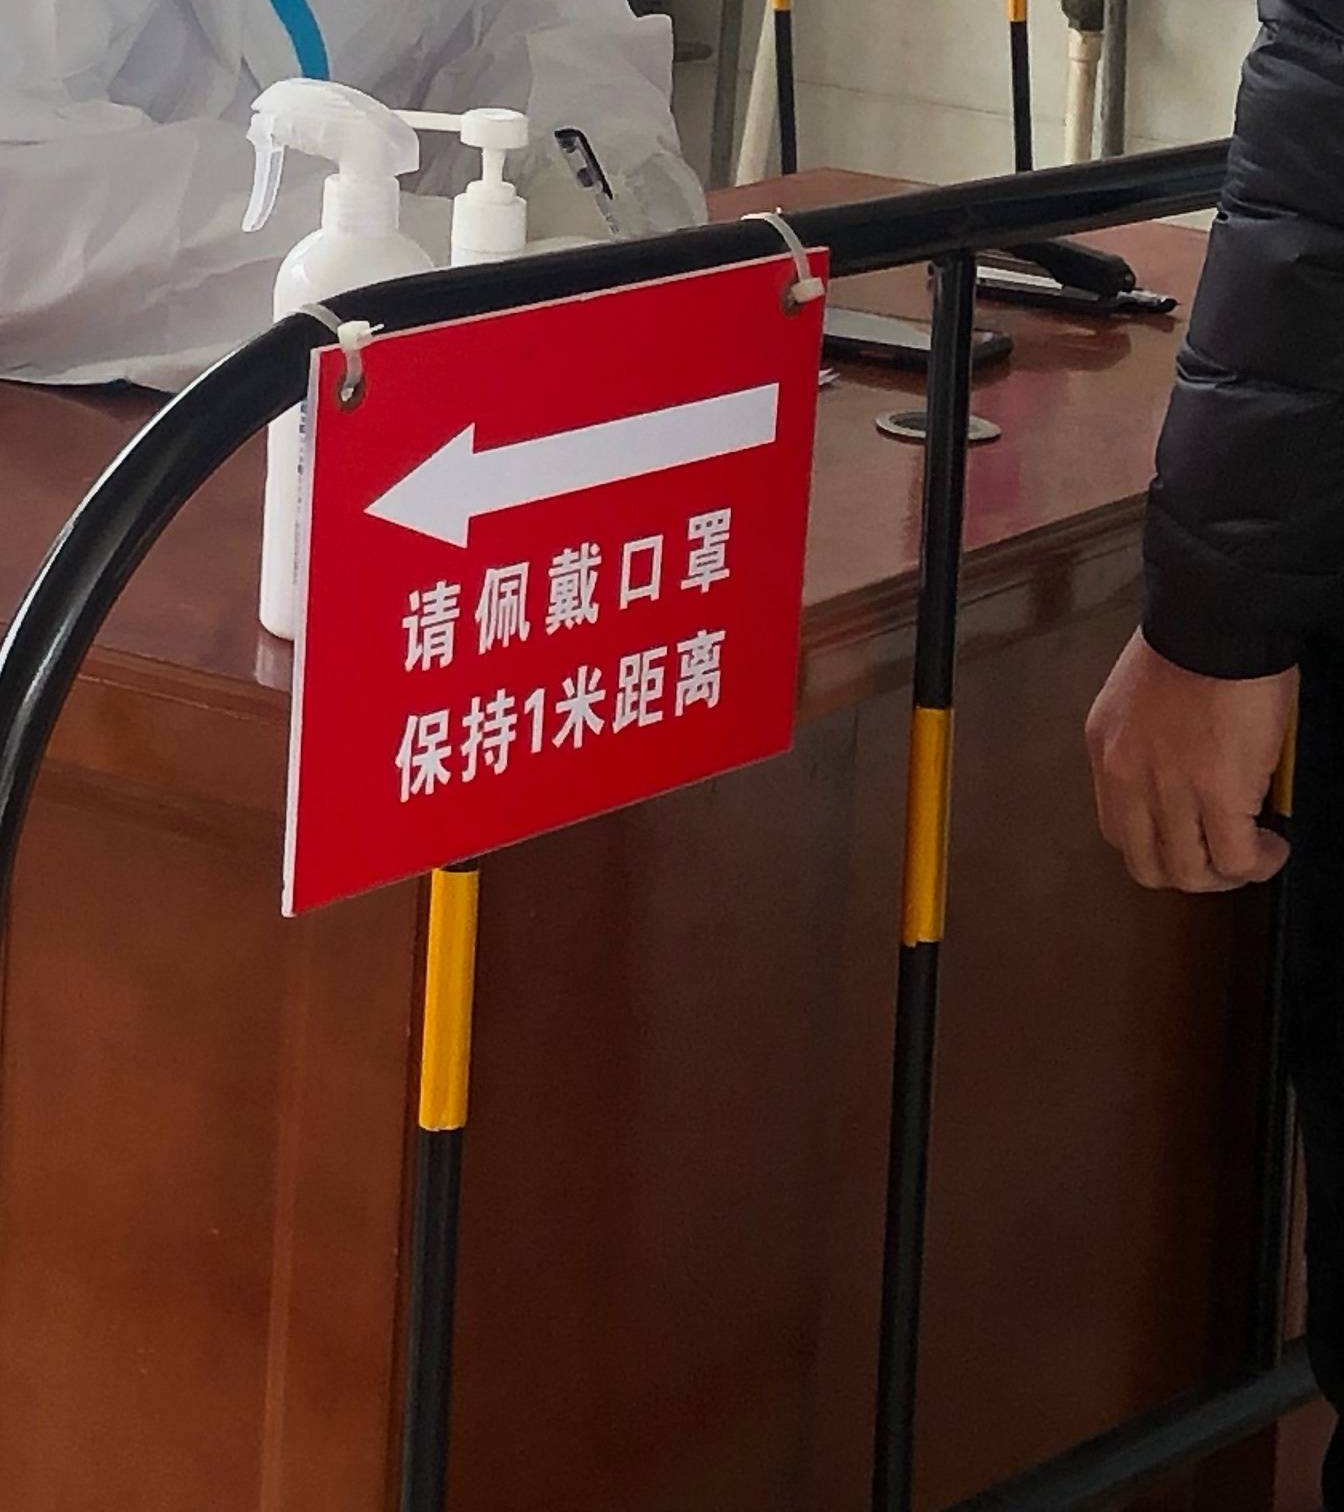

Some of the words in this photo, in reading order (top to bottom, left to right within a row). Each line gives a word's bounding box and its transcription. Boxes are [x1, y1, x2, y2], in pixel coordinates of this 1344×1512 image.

[402, 507, 733, 672] 请佩戴口罩
[394, 629, 727, 803] 保持1米距离
